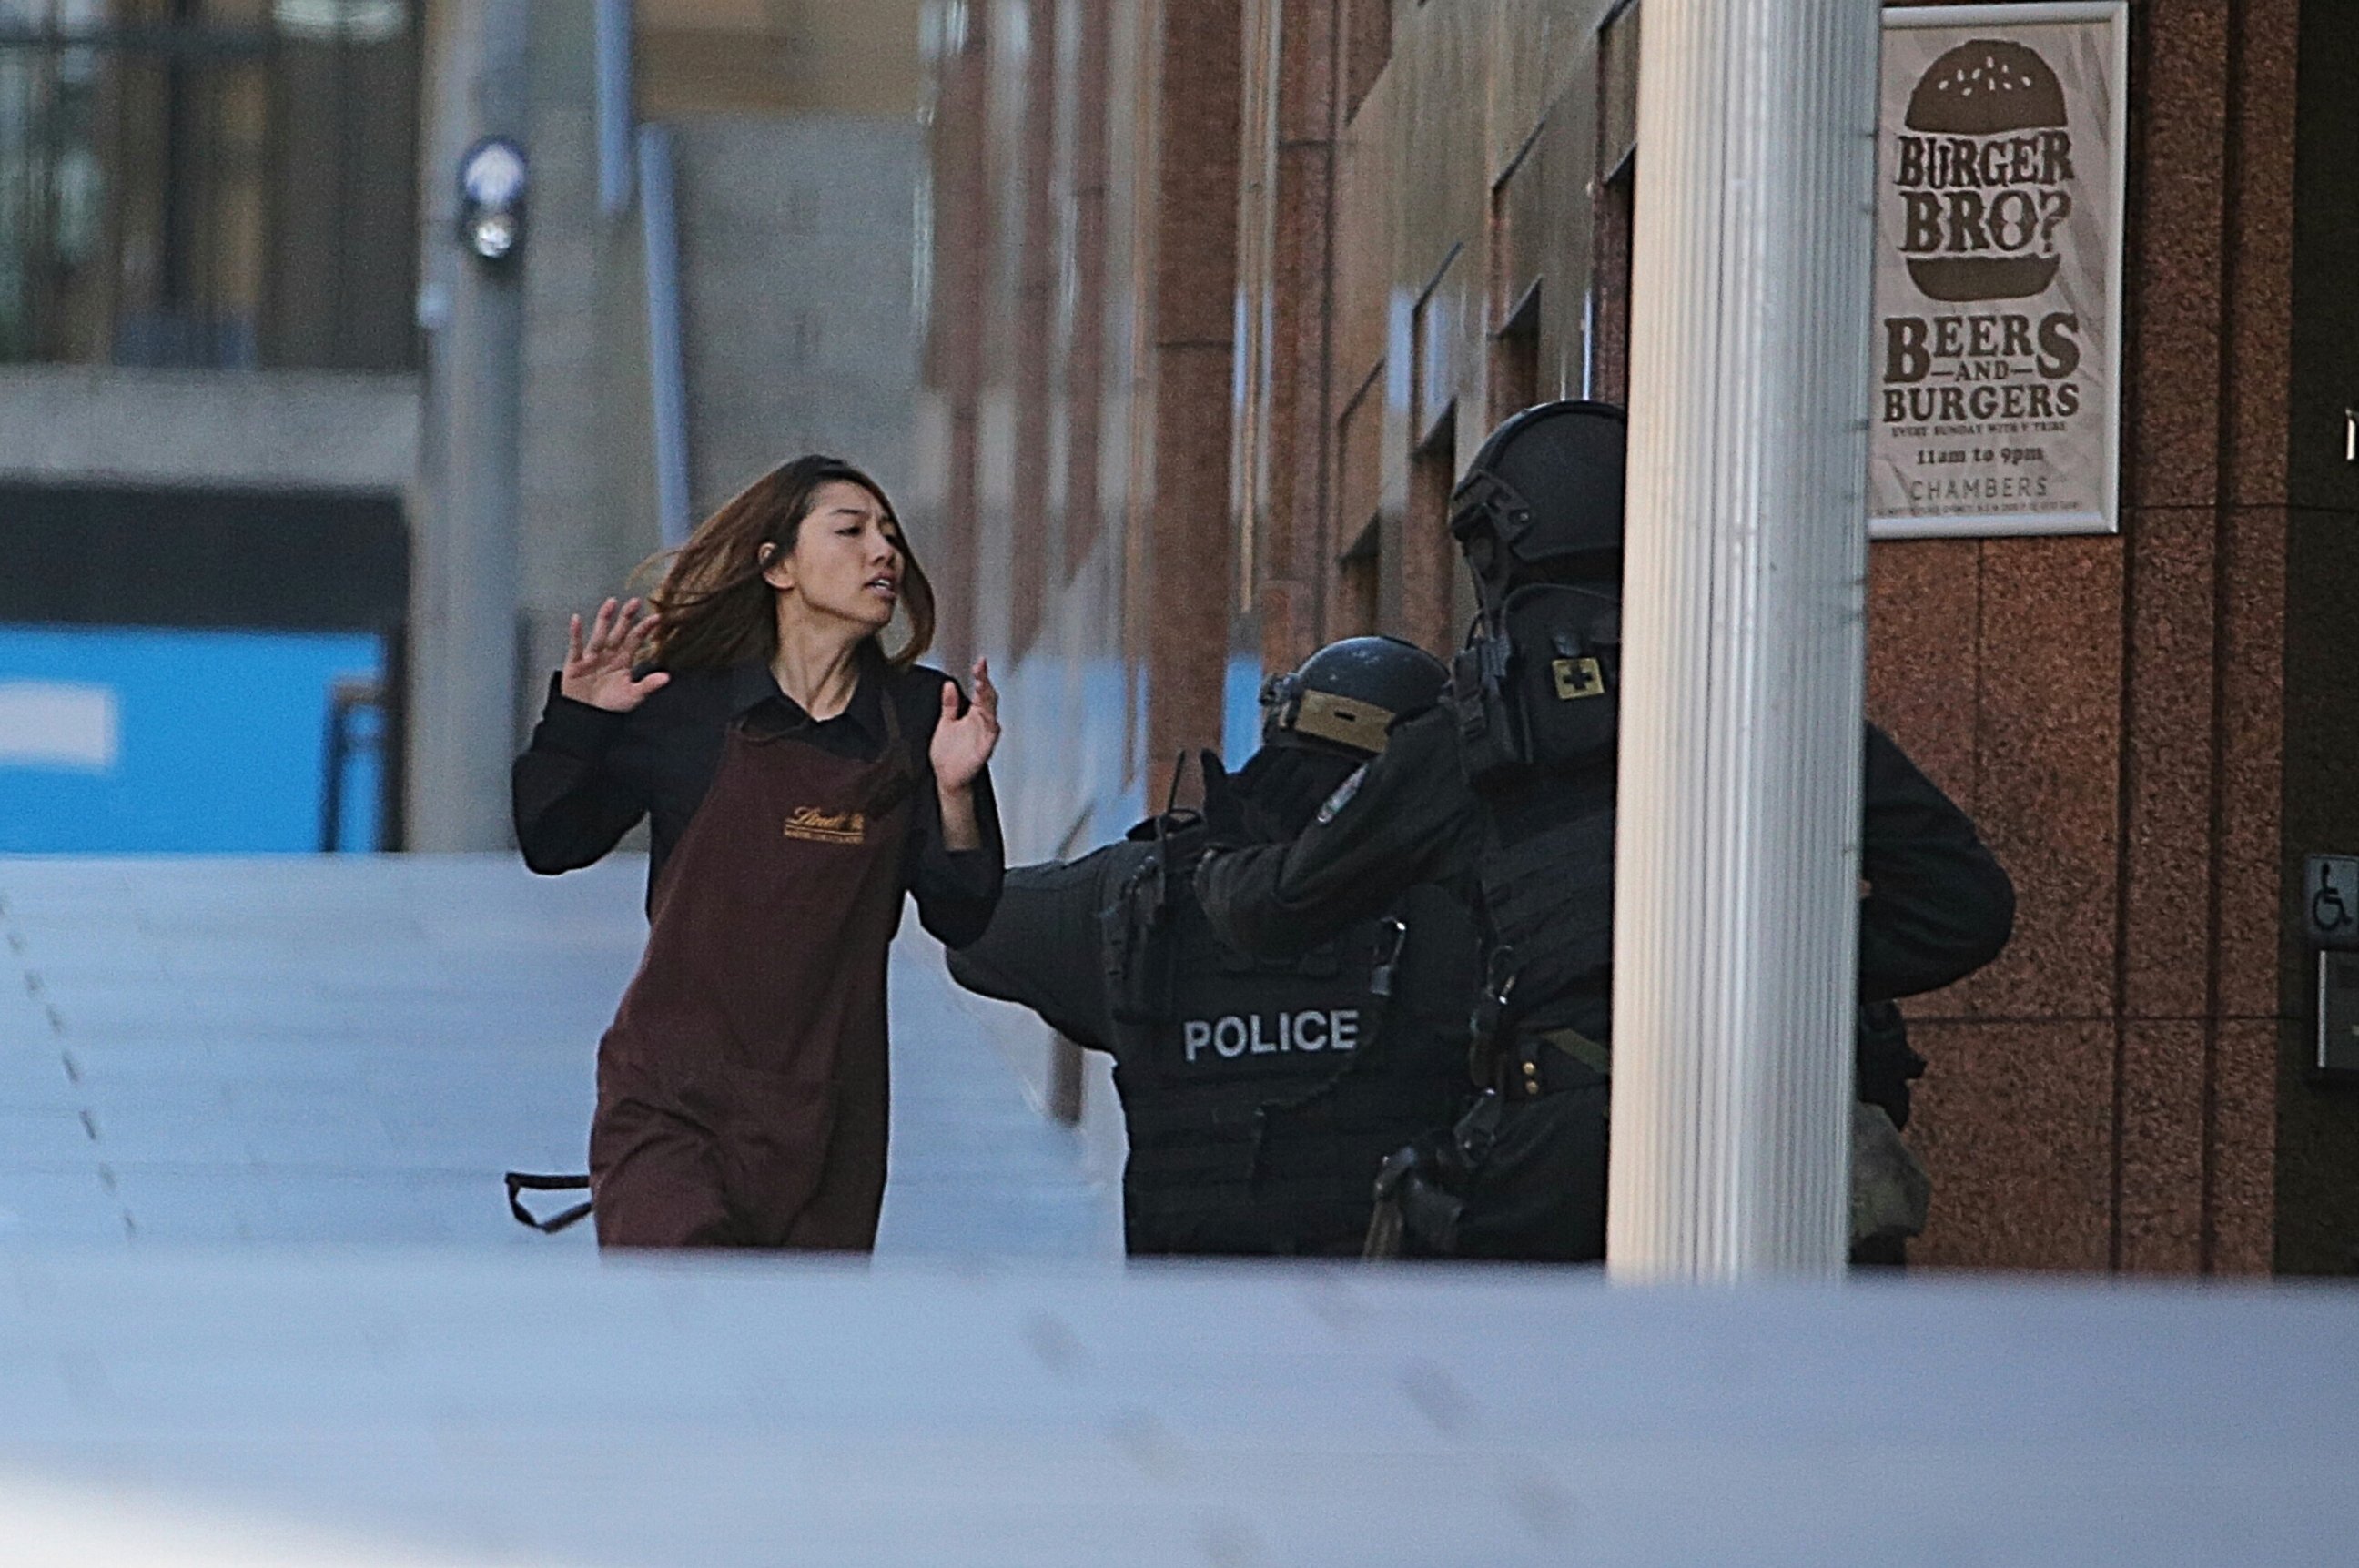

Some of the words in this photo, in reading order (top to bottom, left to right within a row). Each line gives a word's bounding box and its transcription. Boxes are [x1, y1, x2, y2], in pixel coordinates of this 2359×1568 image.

[1894, 131, 2075, 189] BURGER
[1897, 189, 2072, 253] BRO?
[1883, 312, 2081, 384] BEERS
[1883, 382, 2080, 422] BURGERS
[1934, 423, 1981, 436] SUNDAY
[1917, 450, 1966, 465] 11am
[1973, 448, 1995, 462] to
[2001, 447, 2044, 465] 9pm
[1911, 477, 2048, 501] CHAMBERS
[1184, 1009, 1359, 1062] POLICE
